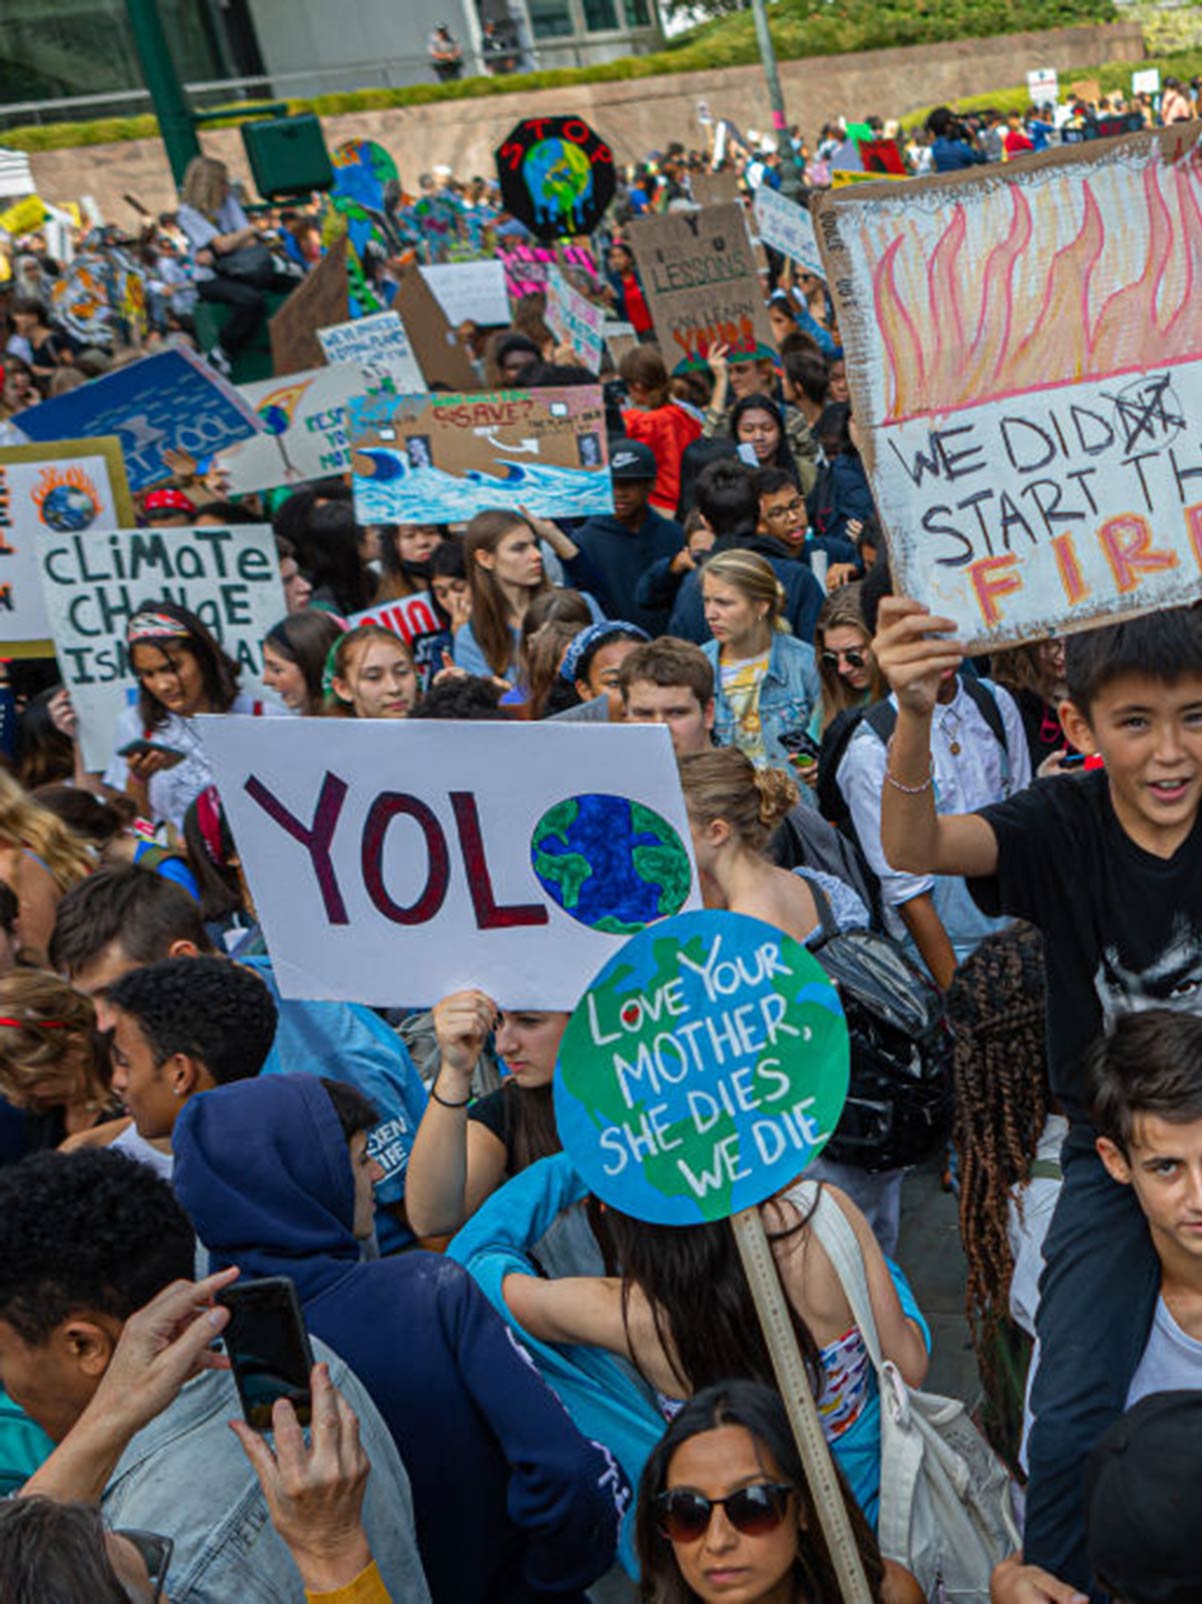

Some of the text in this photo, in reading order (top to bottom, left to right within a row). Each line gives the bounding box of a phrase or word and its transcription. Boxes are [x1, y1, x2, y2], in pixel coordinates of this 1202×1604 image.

[500, 118, 614, 171] STOP
[652, 255, 749, 292] LESSONS
[888, 423, 987, 488] WE
[921, 467, 1099, 566] START
[586, 933, 795, 1046] LOVE YOUR
[612, 992, 813, 1110] MOTHER,
[600, 1058, 791, 1176] SHE DIES
[675, 1096, 832, 1198] WE DIE
